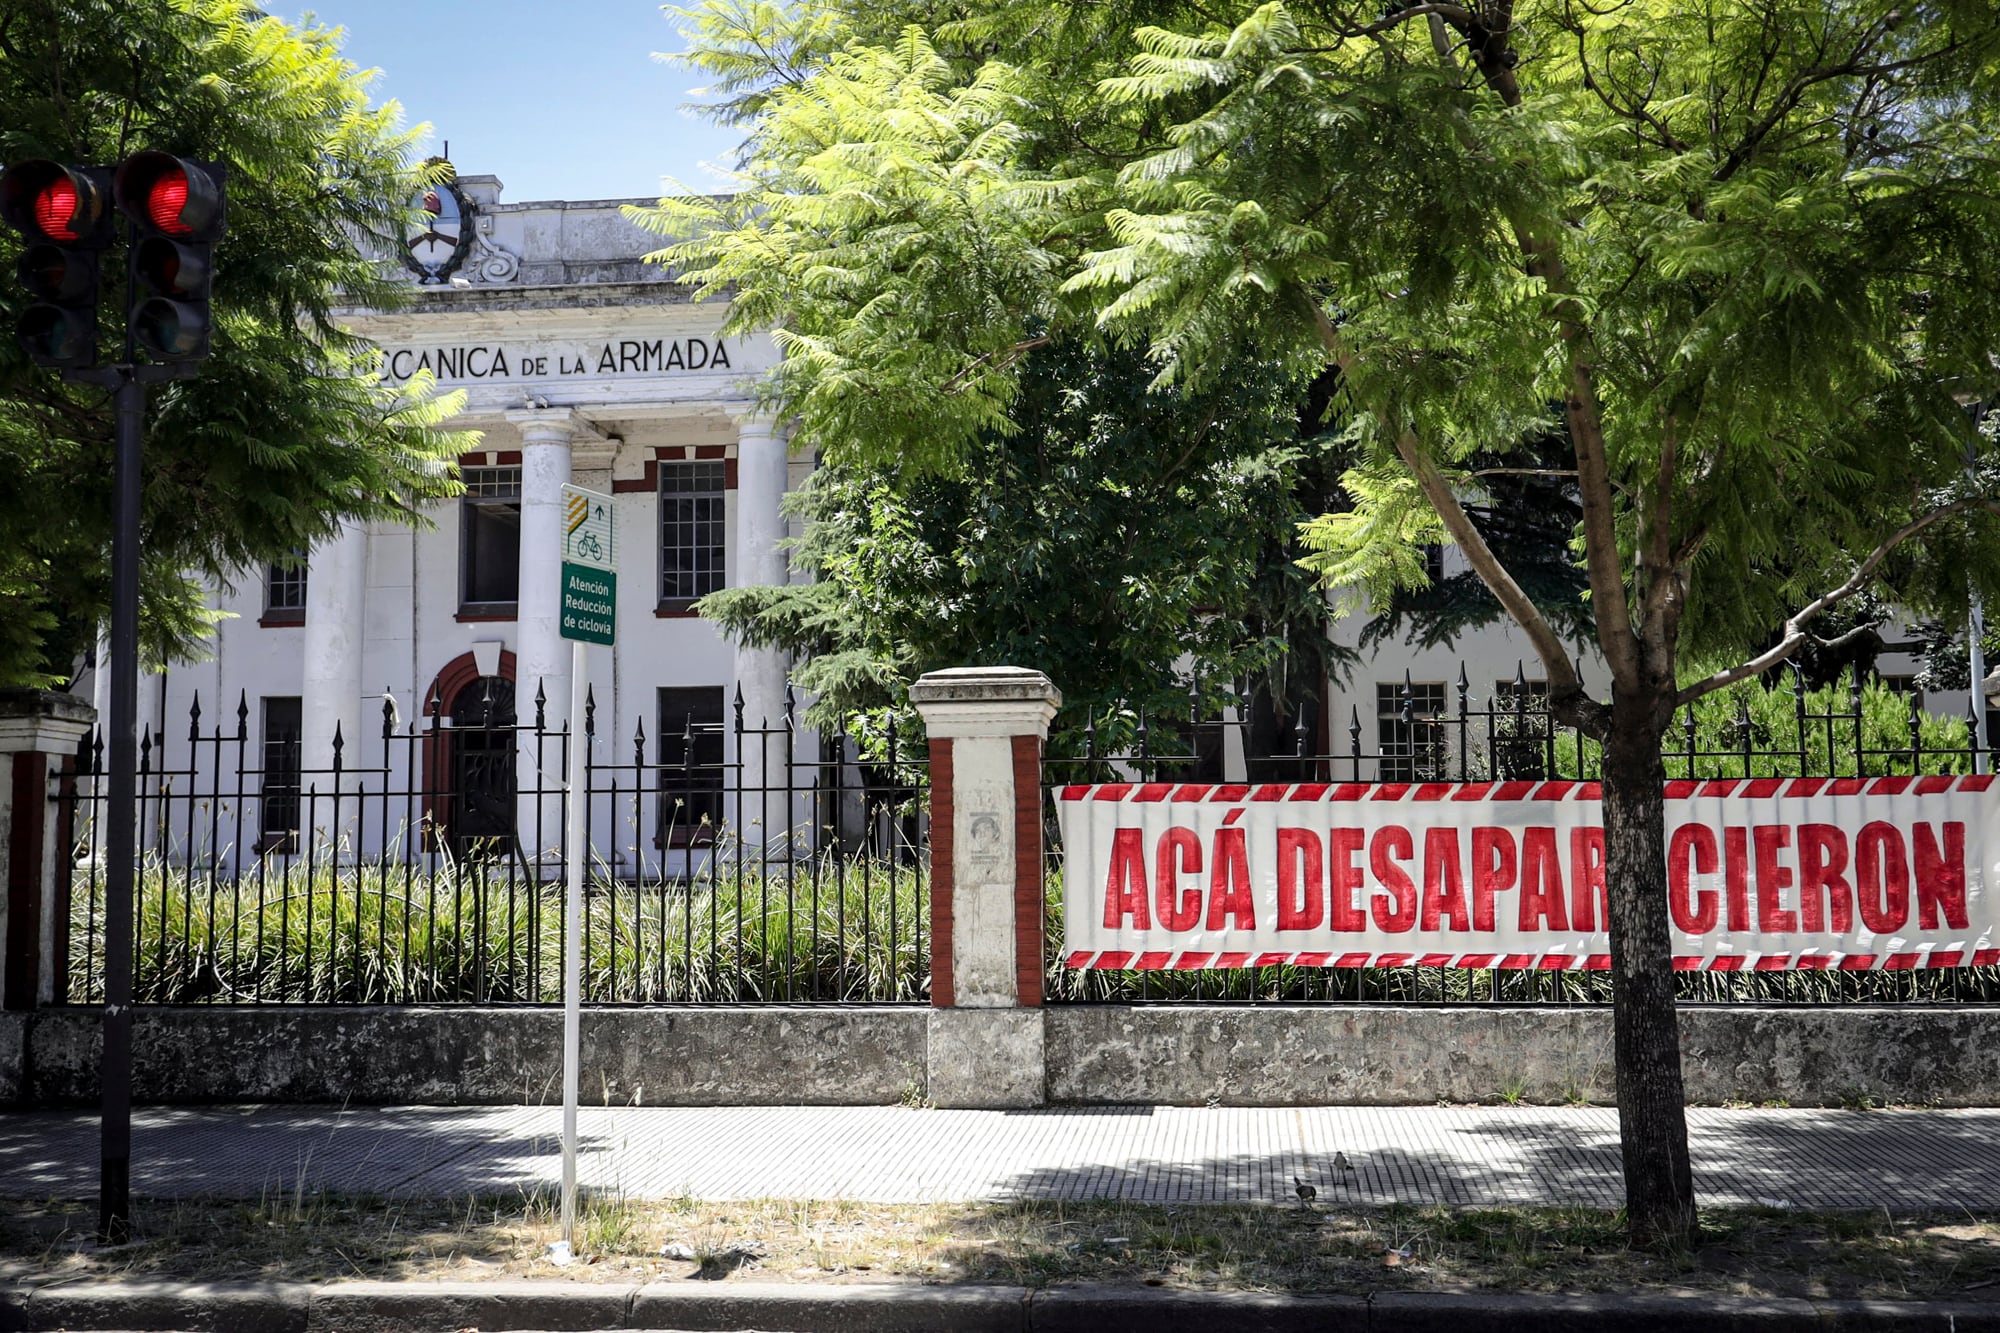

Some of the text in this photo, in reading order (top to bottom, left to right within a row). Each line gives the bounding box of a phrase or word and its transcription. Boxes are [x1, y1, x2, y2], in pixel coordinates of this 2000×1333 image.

[521, 357, 548, 376] DE
[559, 356, 586, 375] LA
[597, 338, 731, 373] ARMADA
[569, 576, 609, 596] Atención
[565, 594, 612, 616] Reducción
[564, 614, 612, 635] de ciclovía
[1103, 807, 1969, 934] ACÁ DESAPARCIERON
